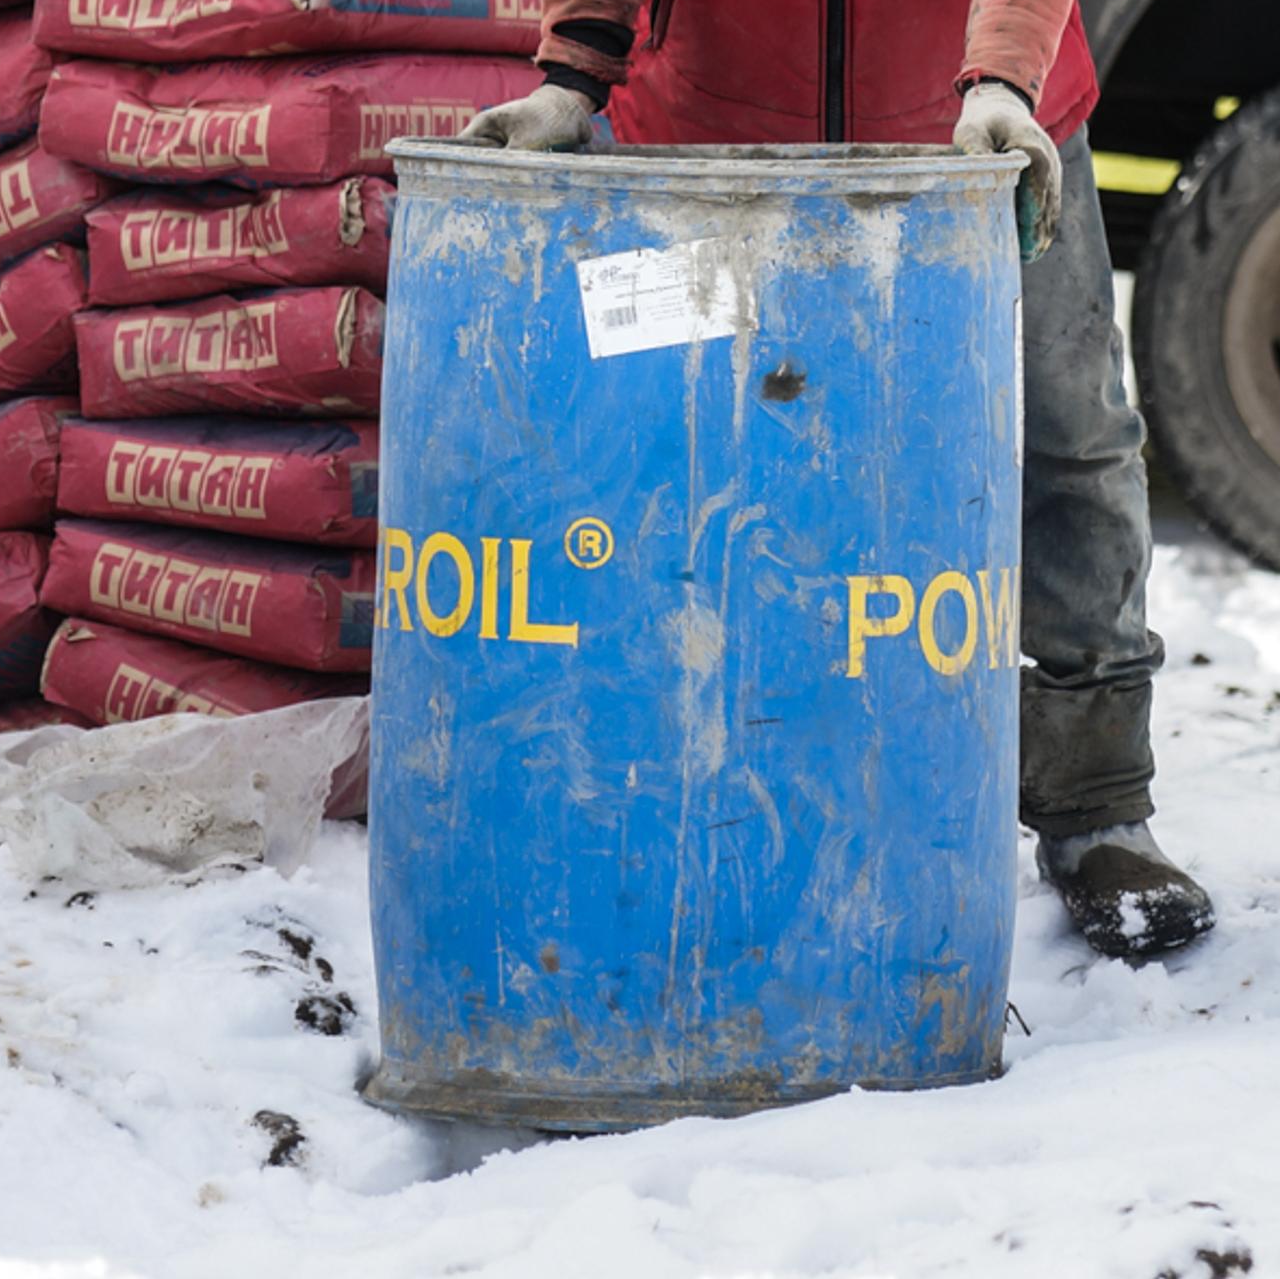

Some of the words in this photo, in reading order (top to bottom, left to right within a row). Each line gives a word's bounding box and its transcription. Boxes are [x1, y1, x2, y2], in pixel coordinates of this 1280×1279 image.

[108, 102, 271, 167] ТИТАН
[115, 304, 278, 380] ТИТАН
[107, 442, 273, 518] ТИТАН
[91, 544, 261, 636] ТИТАН
[377, 527, 579, 648] ROIL
